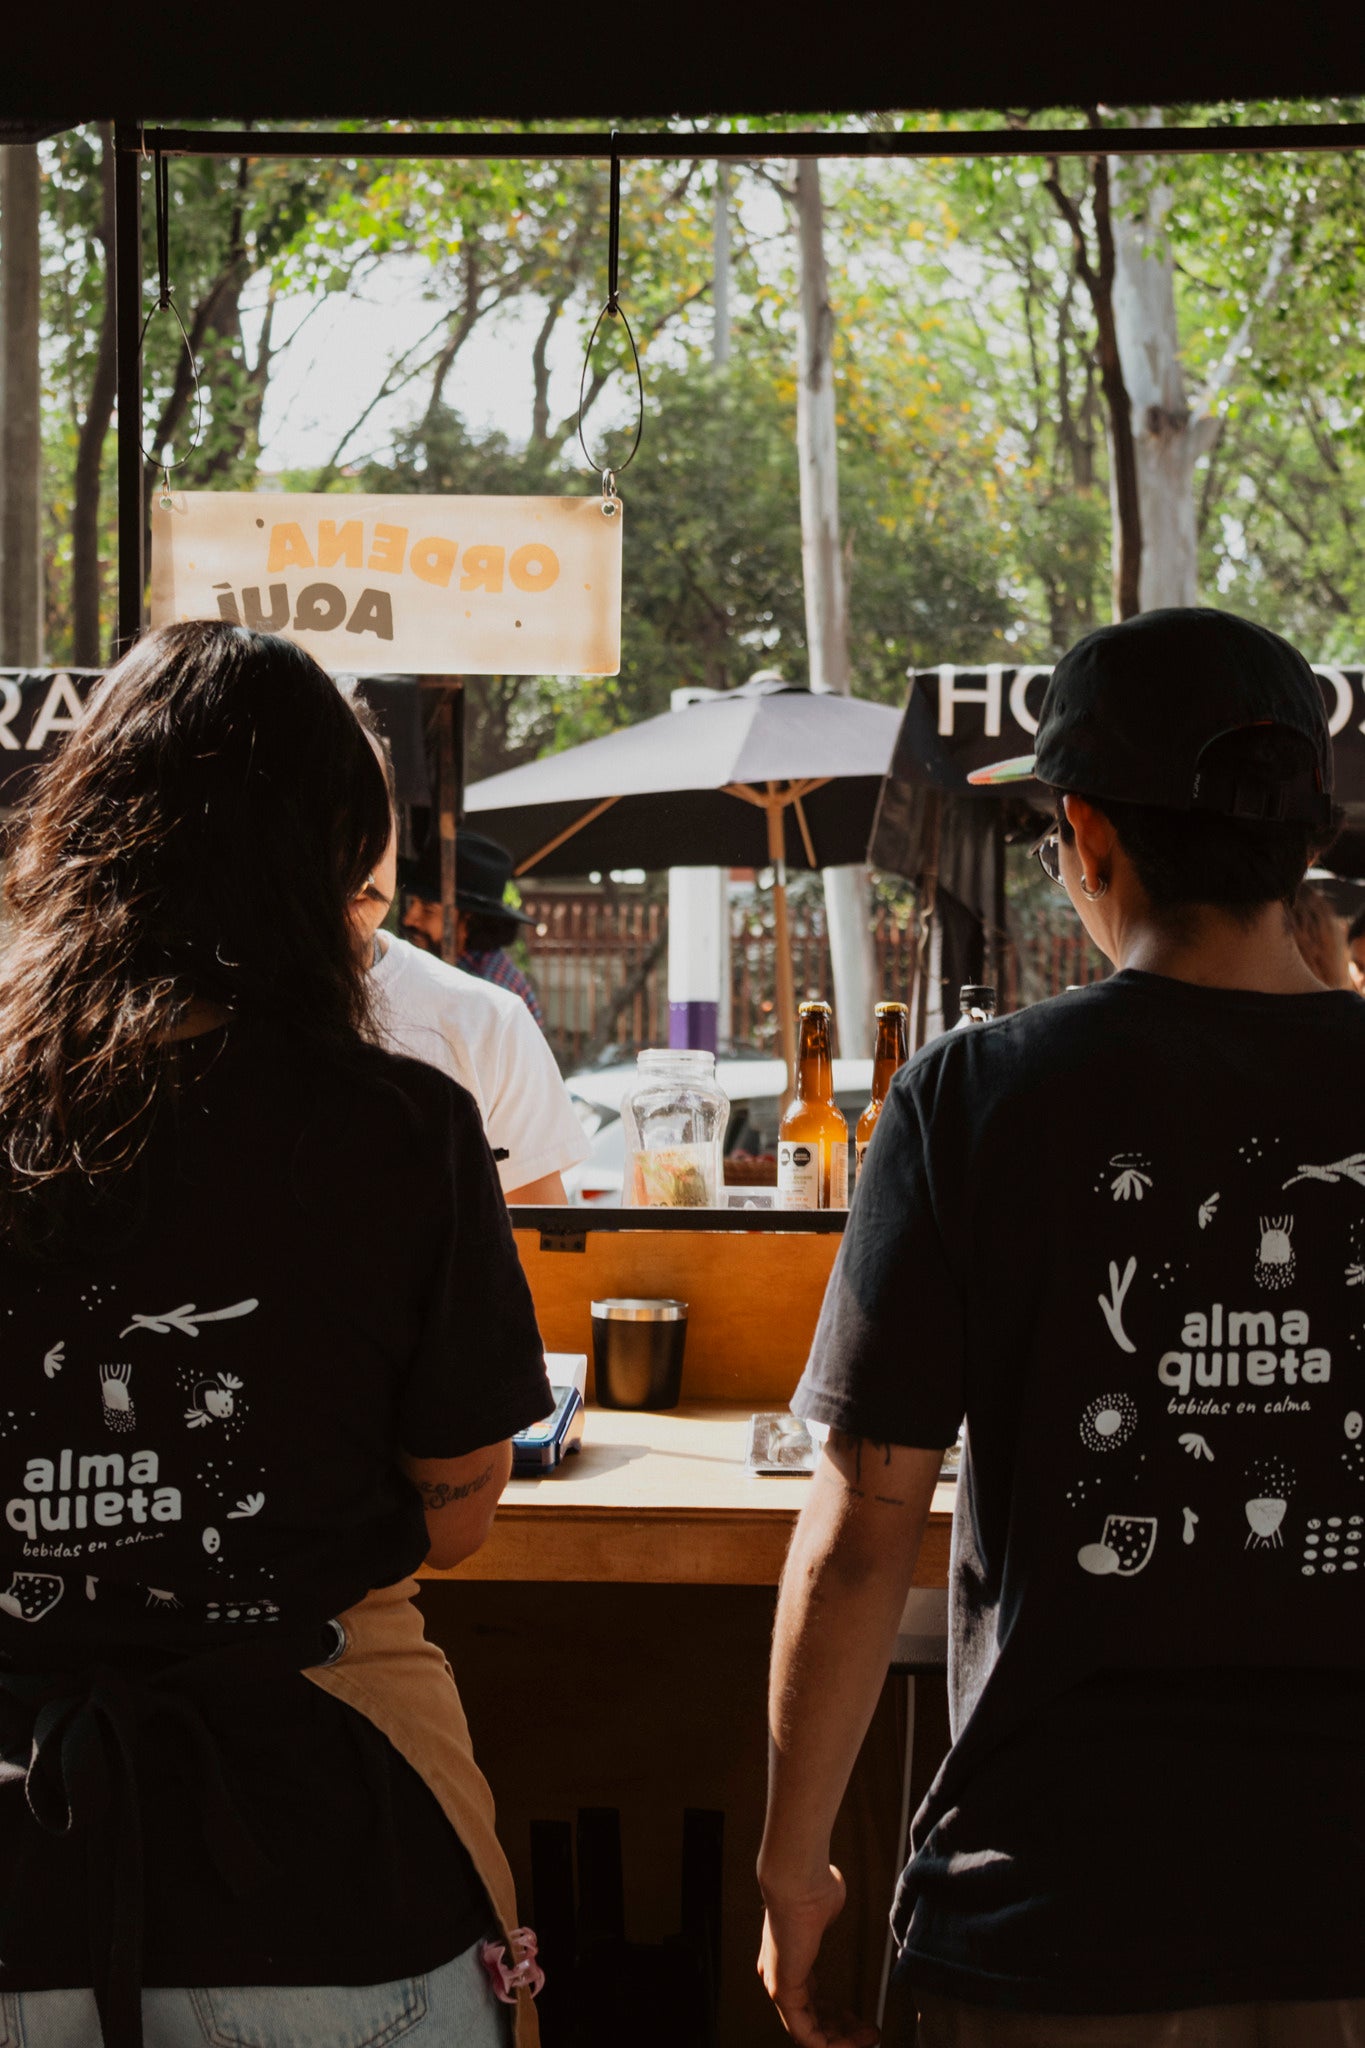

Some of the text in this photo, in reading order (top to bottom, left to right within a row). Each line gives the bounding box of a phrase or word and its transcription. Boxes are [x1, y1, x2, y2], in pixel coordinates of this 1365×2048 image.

[1180, 1303, 1310, 1348] alma
[1157, 1348, 1332, 1396] quieta
[1166, 1395, 1312, 1416] bebidas en calma
[23, 1448, 159, 1493] alma
[5, 1486, 182, 1540] quieta
[22, 1542, 82, 1558] bebidas
[88, 1540, 108, 1553] en
